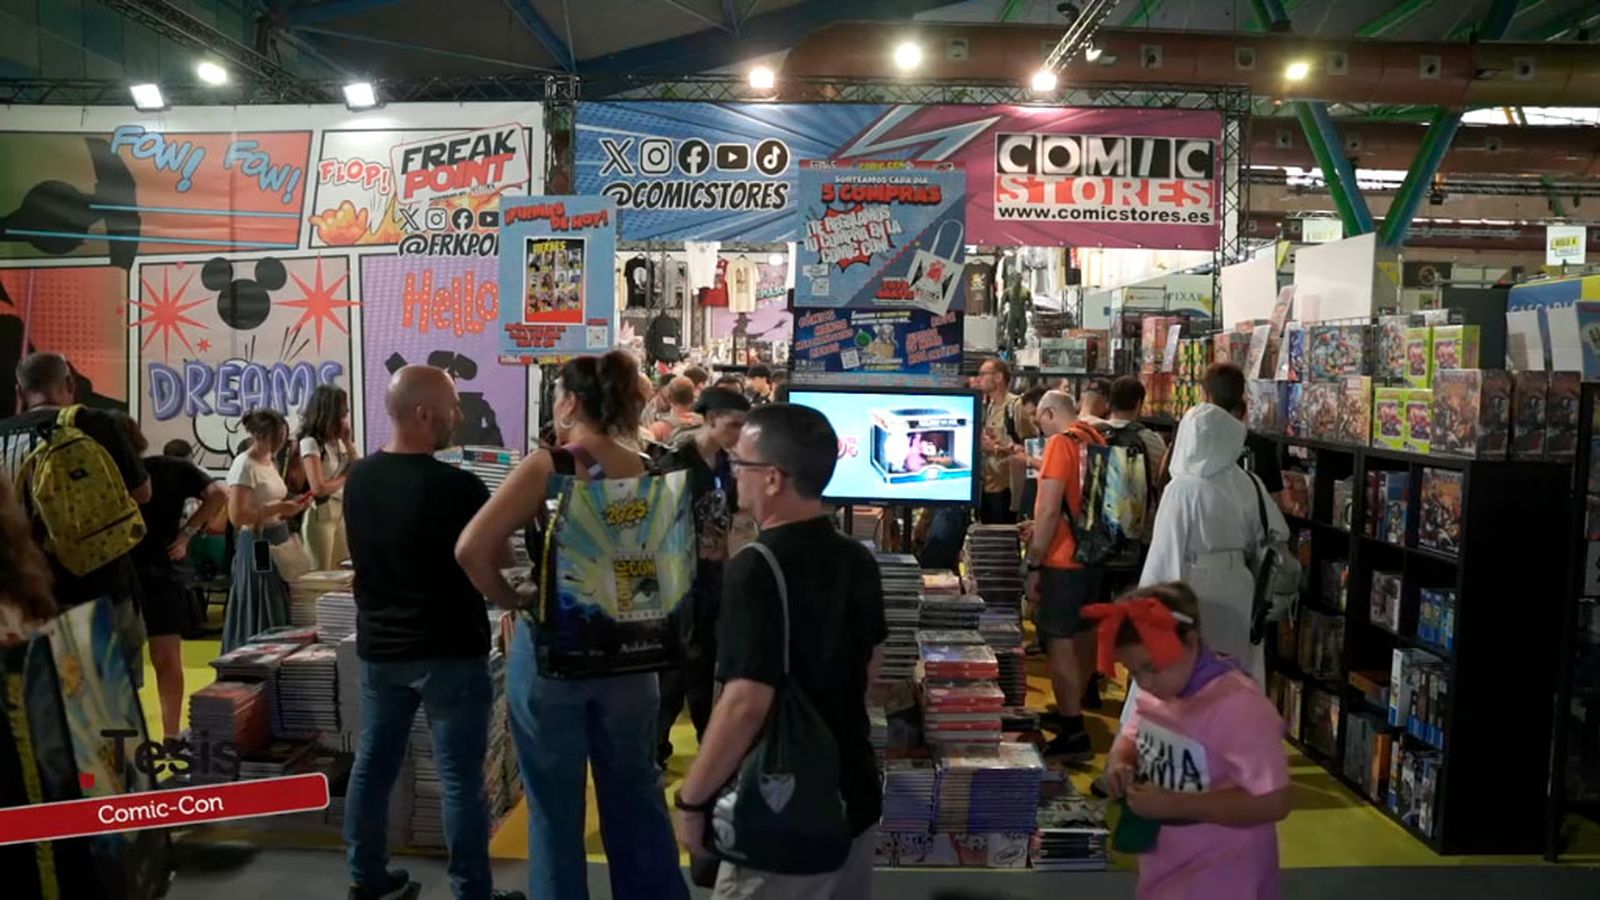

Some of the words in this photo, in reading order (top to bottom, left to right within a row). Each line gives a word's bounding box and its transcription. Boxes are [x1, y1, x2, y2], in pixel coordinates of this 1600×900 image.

[111, 124, 206, 192] FOW!
[224, 140, 301, 204] FOW!
[401, 129, 517, 175] FREAK
[998, 134, 1211, 178] COMIC
[319, 160, 390, 193] FLOP!
[403, 153, 514, 198] POINT
[999, 176, 1211, 208] STORES
[602, 181, 788, 210] @COMICSTORES
[821, 184, 836, 203] 5
[839, 184, 942, 204] COMPRAS
[998, 205, 1210, 224] www.comicstores.es
[402, 269, 498, 337] Hello
[606, 499, 648, 525] 2025
